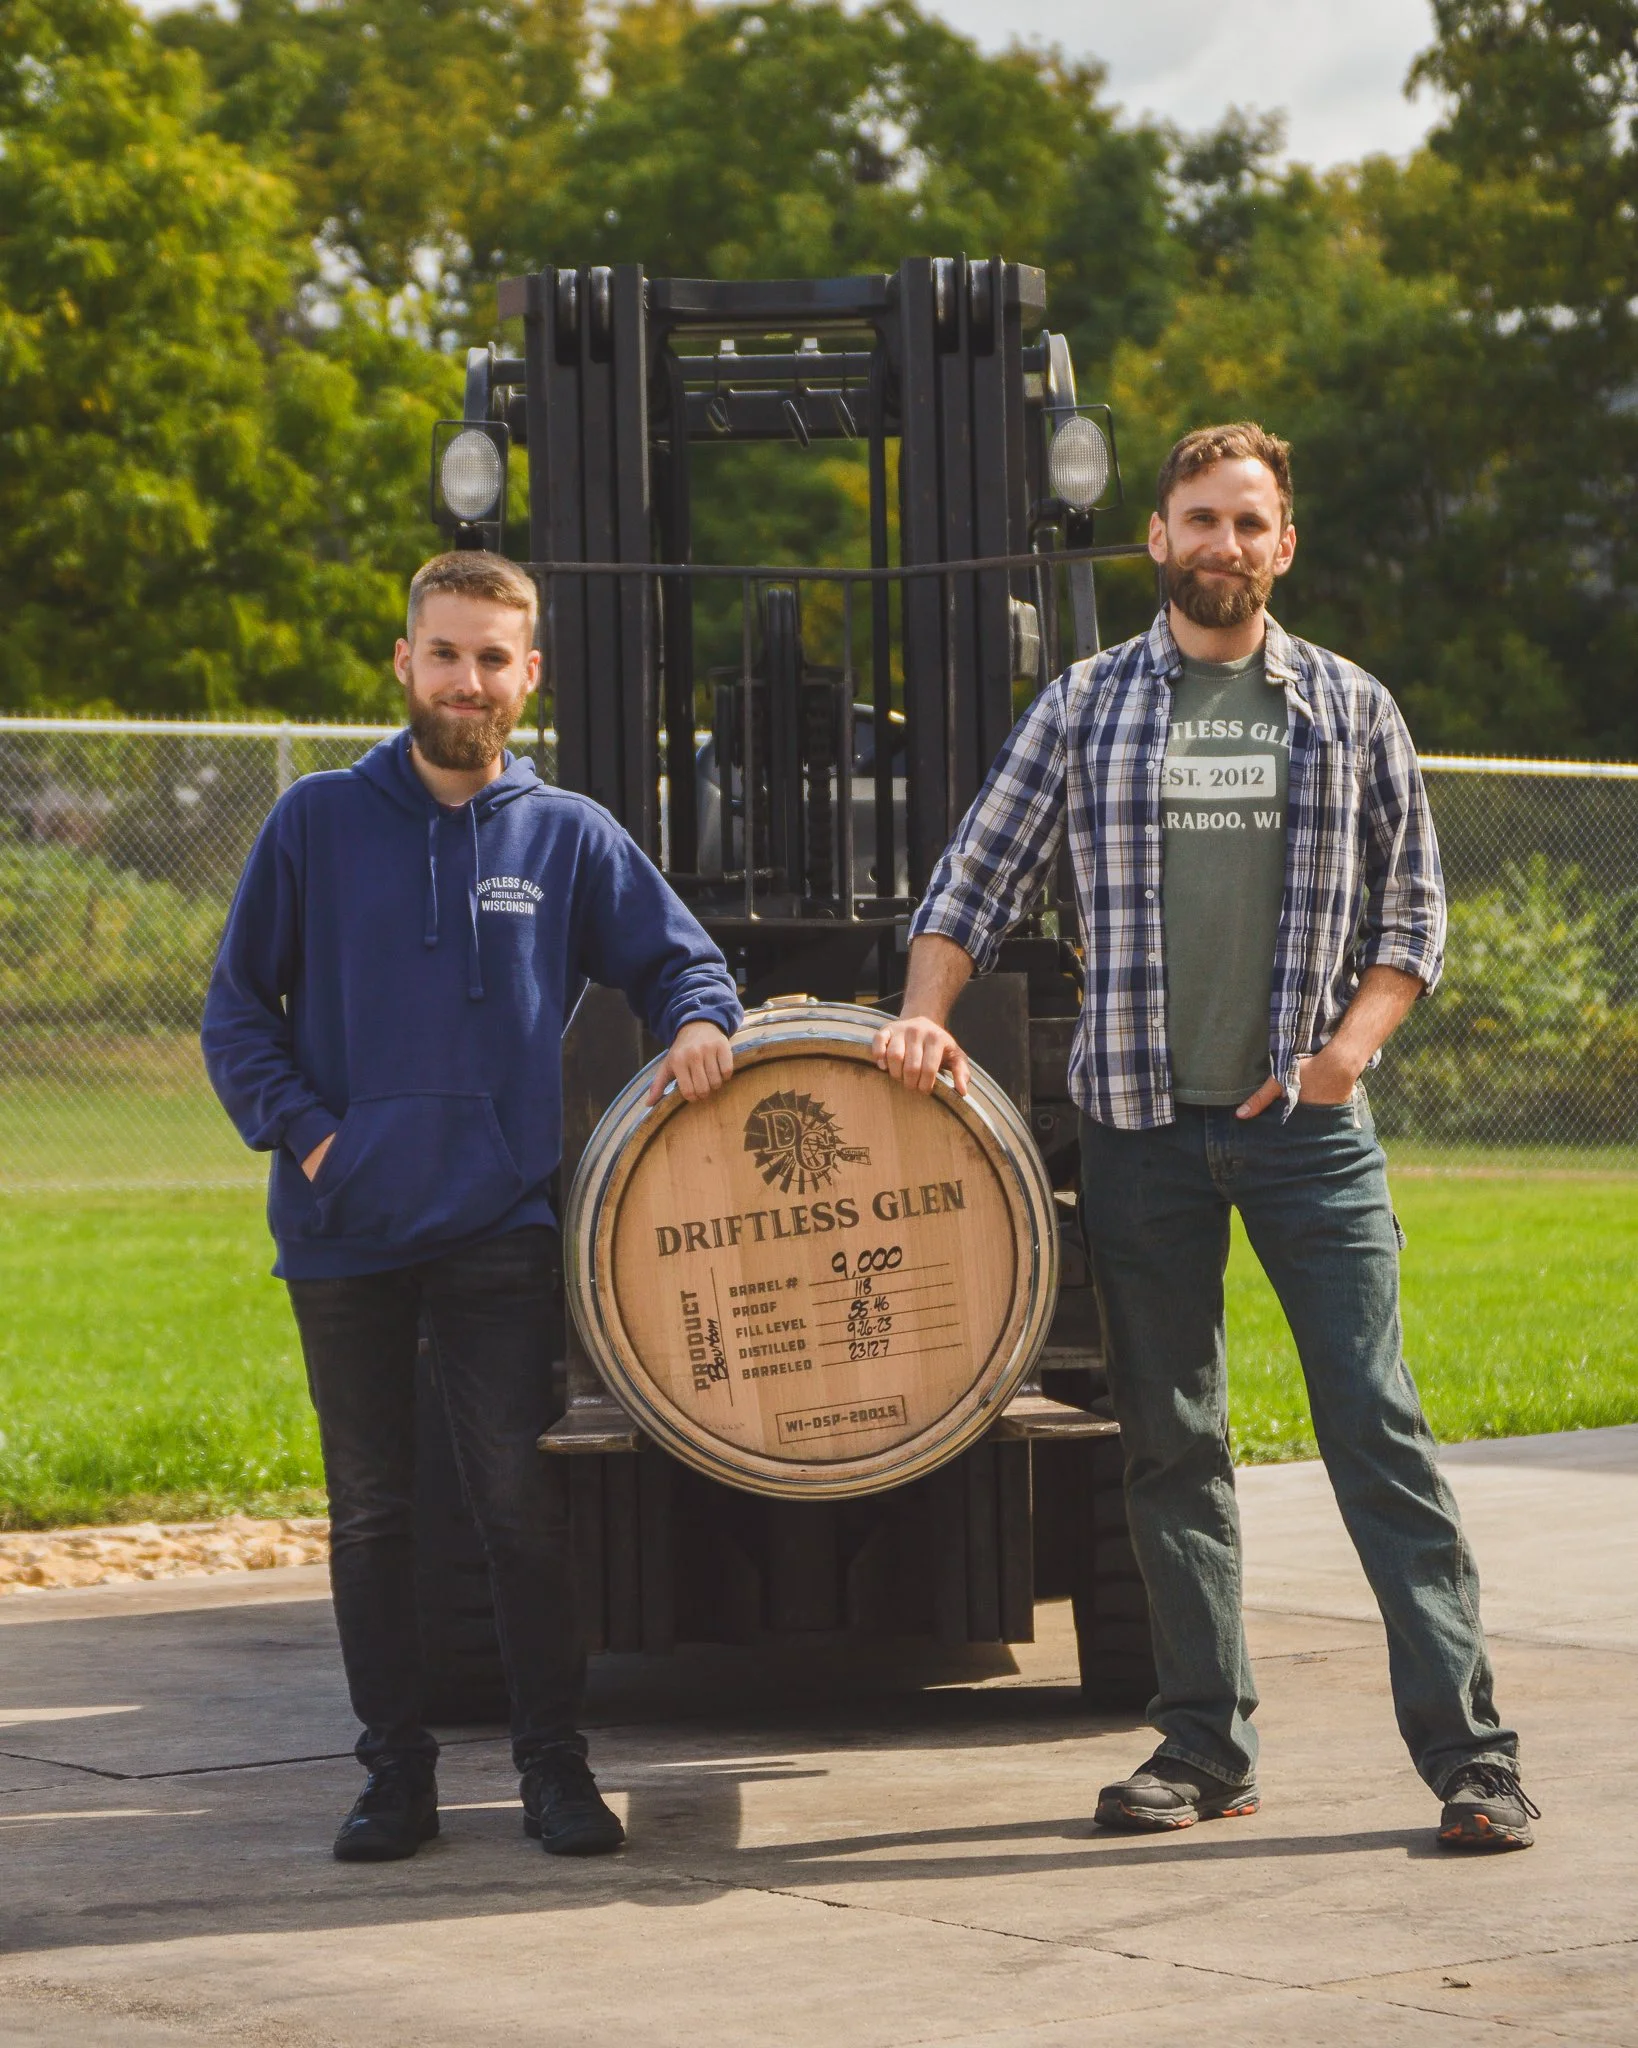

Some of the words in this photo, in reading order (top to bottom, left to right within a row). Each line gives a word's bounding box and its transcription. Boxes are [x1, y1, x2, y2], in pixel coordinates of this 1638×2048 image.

[1168, 717, 1244, 740] TLESS
[1210, 766, 1265, 787] 2012
[1161, 811, 1247, 830] RABOO,
[1253, 811, 1281, 829] WI
[477, 877, 520, 896] RIFTLESS
[522, 880, 545, 902] GLEN
[491, 890, 525, 900] DISTILLERY
[481, 900, 534, 915] WISCONSIN
[655, 1198, 860, 1257] DRIFTLESS
[872, 1179, 966, 1222] GLEN
[831, 1245, 903, 1280] 9,000
[729, 1280, 783, 1298] BARREL
[855, 1277, 872, 1297] 118
[732, 1301, 777, 1318] PROOF
[736, 1325, 764, 1339] FILL
[766, 1318, 807, 1334] LEVEL
[680, 1290, 711, 1392] PRODUCT
[704, 1318, 729, 1383] Bourbon
[739, 1338, 806, 1360] DISTILLED
[742, 1359, 813, 1381] BARRELED
